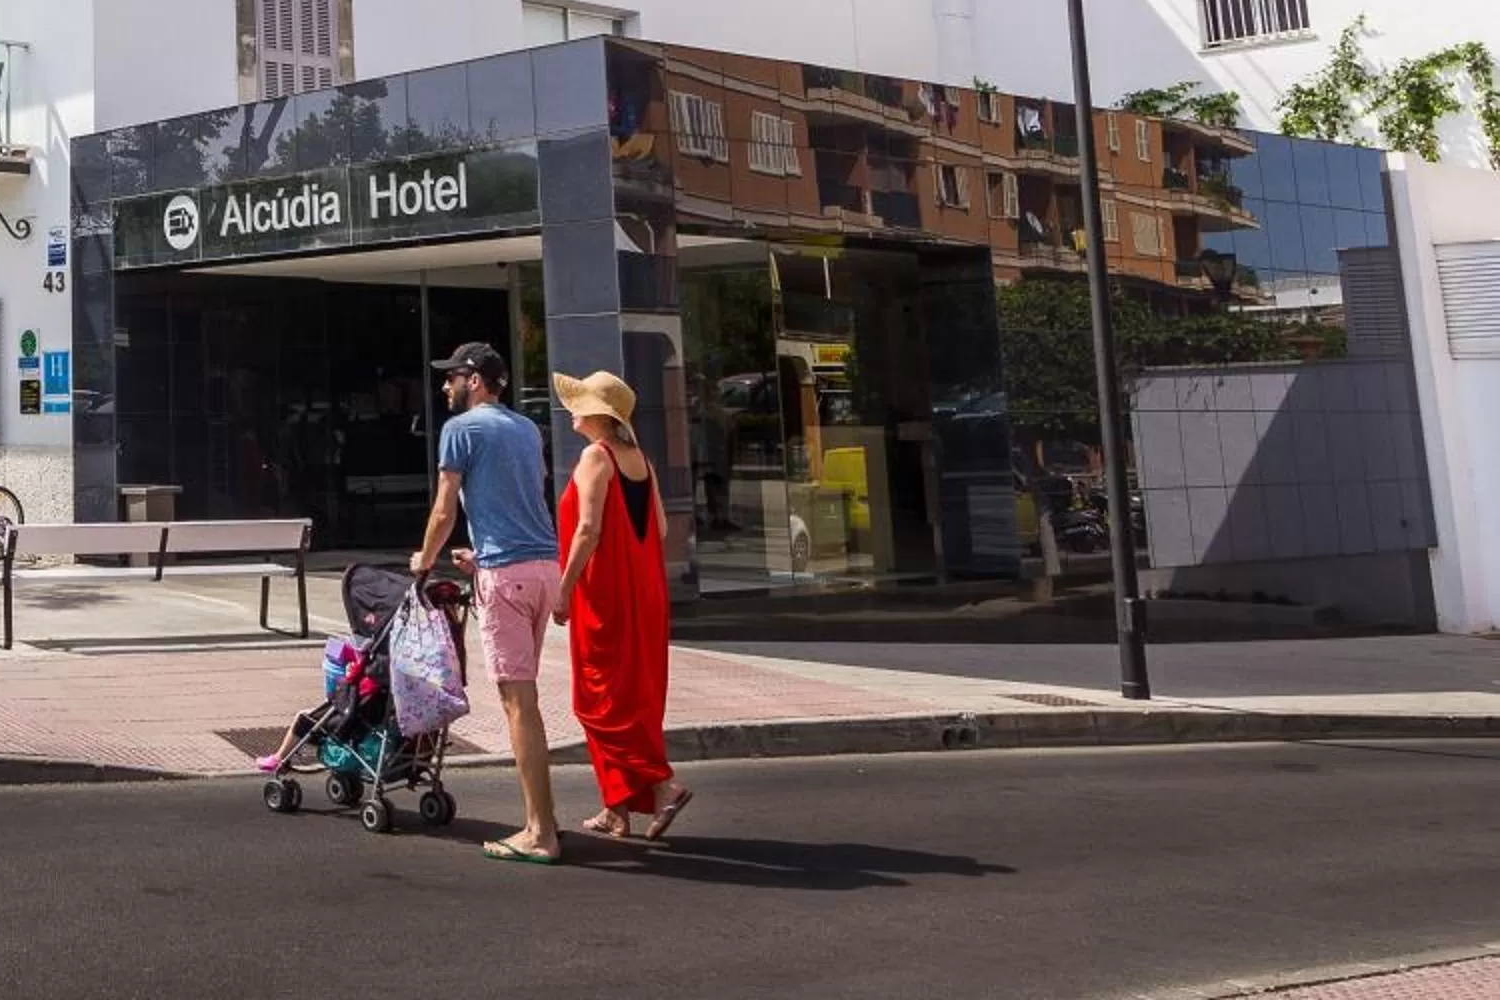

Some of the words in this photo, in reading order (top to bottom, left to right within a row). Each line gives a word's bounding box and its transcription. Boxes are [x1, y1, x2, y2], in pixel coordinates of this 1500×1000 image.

[219, 182, 342, 238] Alcúdia
[368, 161, 468, 219] Hotel
[43, 271, 65, 293] 43
[51, 355, 63, 377] H
